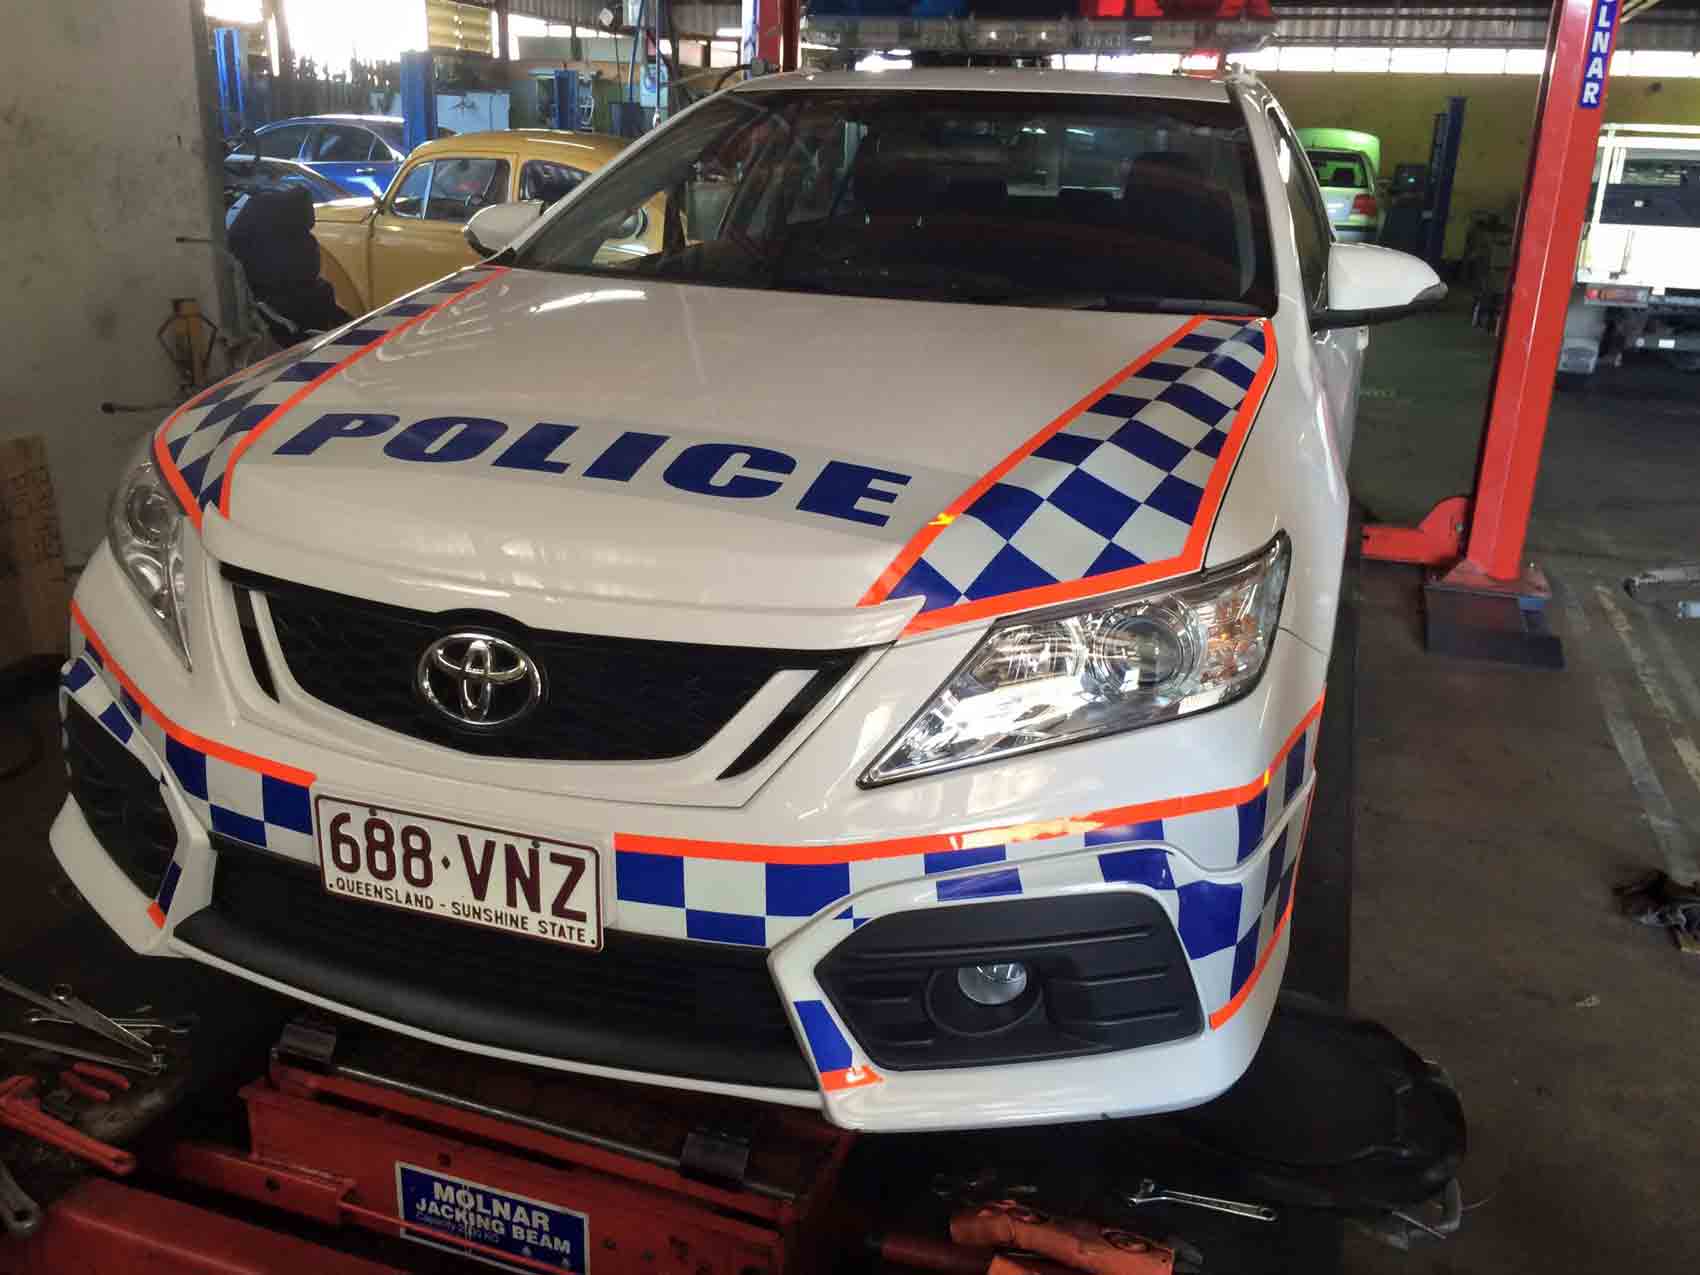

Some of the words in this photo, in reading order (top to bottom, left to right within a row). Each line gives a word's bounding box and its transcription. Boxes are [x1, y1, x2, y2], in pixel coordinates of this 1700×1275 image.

[1582, 0, 1615, 105] LNAR
[272, 412, 912, 527] POLICE
[335, 877, 434, 911] QUEENSLAND
[451, 901, 529, 931] SUNSHINE
[537, 919, 586, 943] STATE
[415, 1197, 505, 1235] JACKING
[511, 1223, 571, 1255] BEAM
[432, 1181, 551, 1233] MOLNAR
